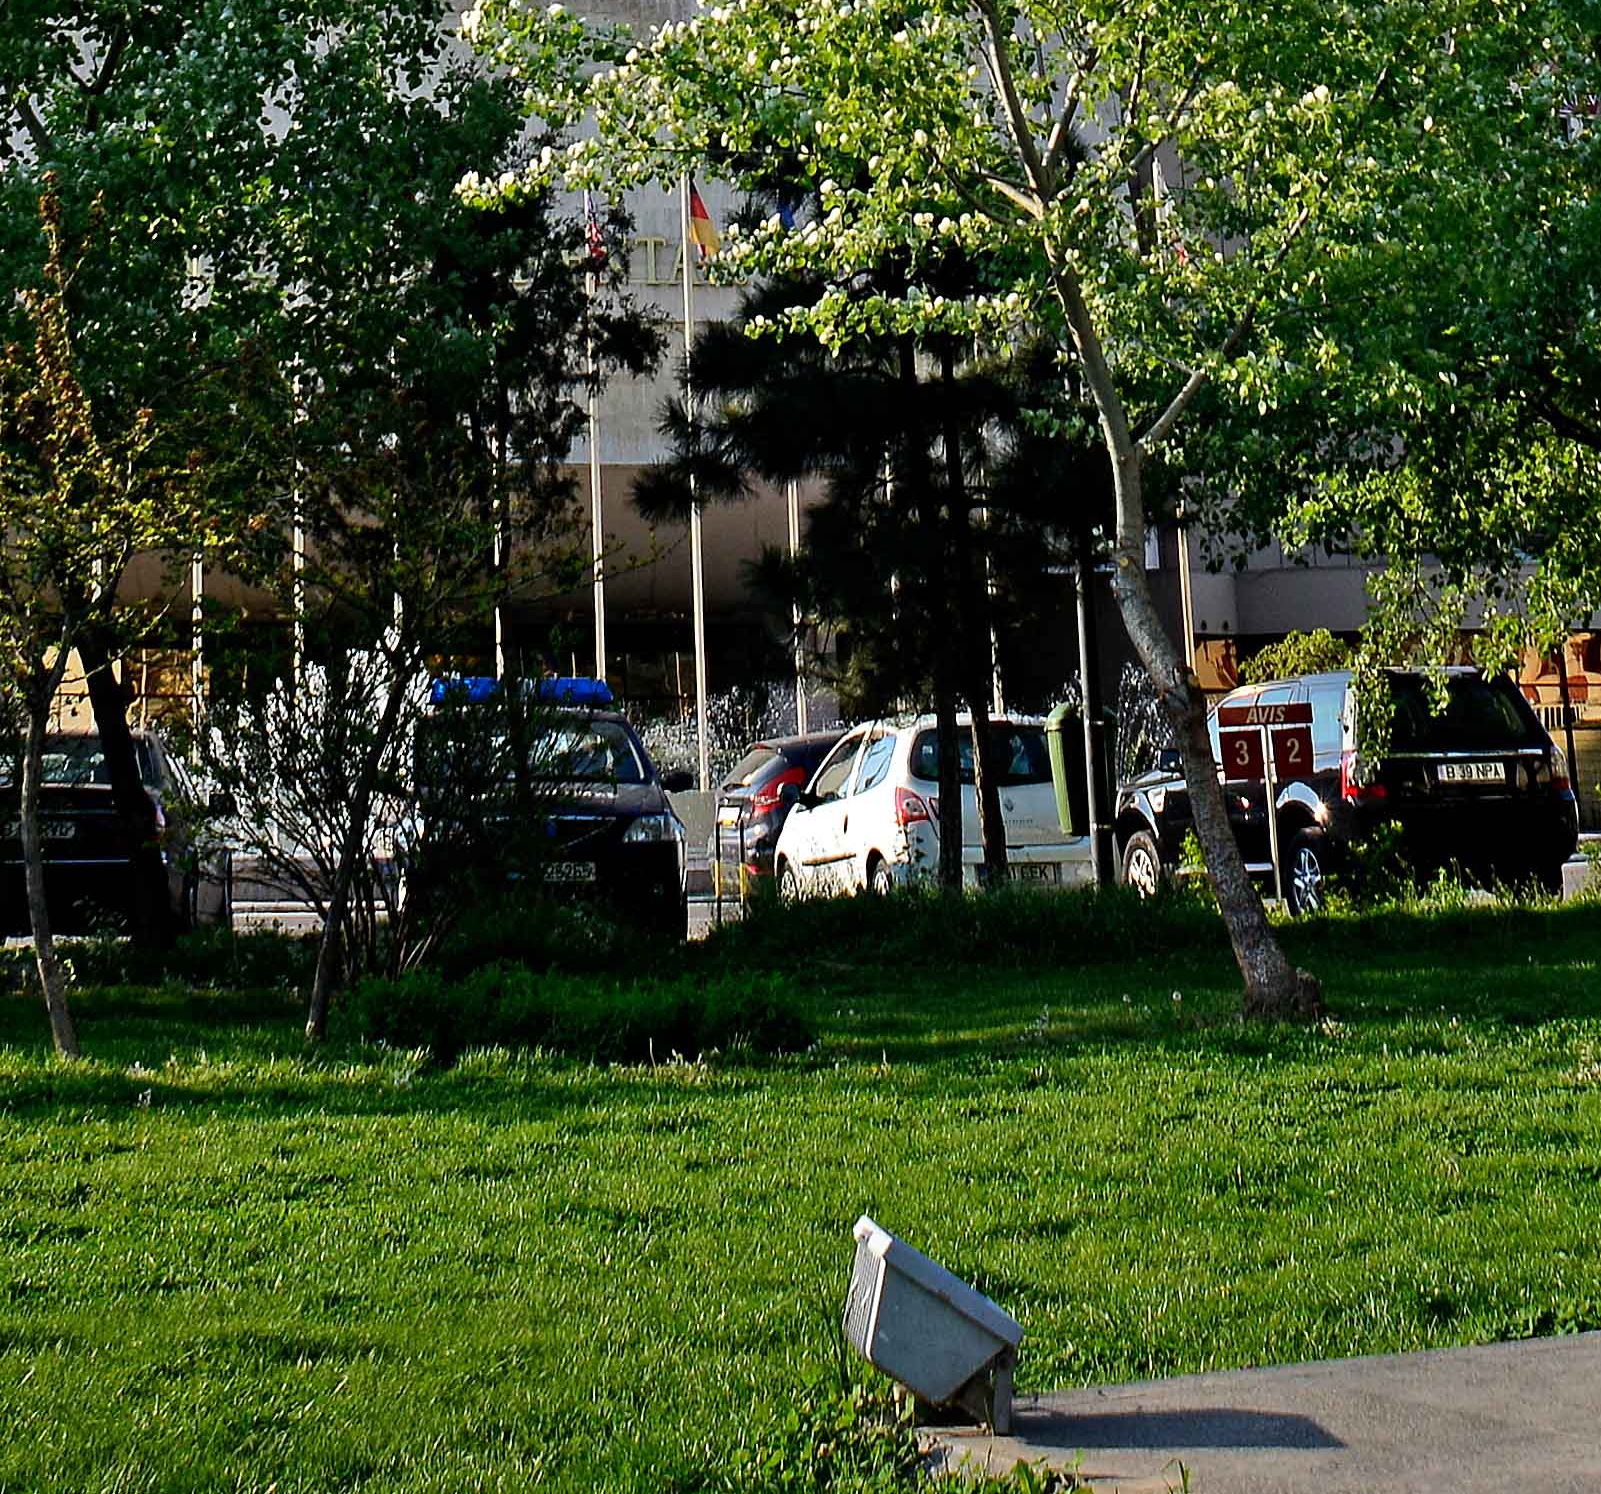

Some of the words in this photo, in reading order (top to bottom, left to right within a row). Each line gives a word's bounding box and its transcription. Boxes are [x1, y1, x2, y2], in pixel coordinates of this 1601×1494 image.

[1246, 706, 1285, 724] AVIS
[1235, 740, 1249, 765] 3
[1287, 738, 1302, 763] 2
